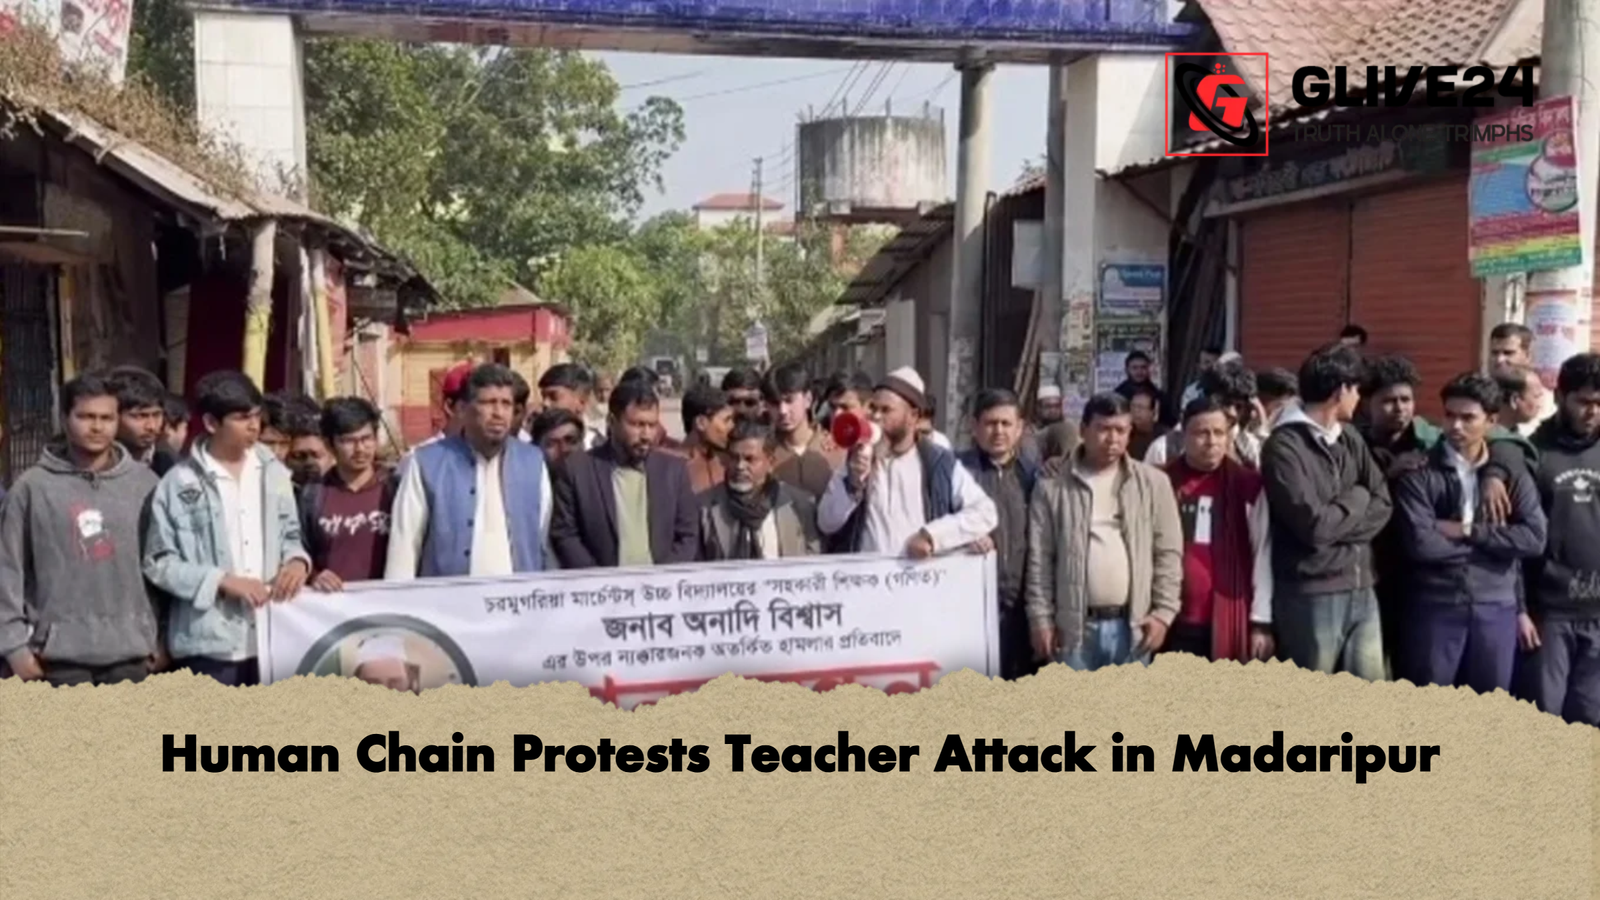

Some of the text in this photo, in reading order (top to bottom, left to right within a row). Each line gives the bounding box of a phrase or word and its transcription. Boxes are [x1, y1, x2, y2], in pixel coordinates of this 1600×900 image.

[601, 597, 844, 641] জনাব অনাদি বিশ্বাস
[542, 653, 568, 671] এর
[572, 647, 612, 667] উপর
